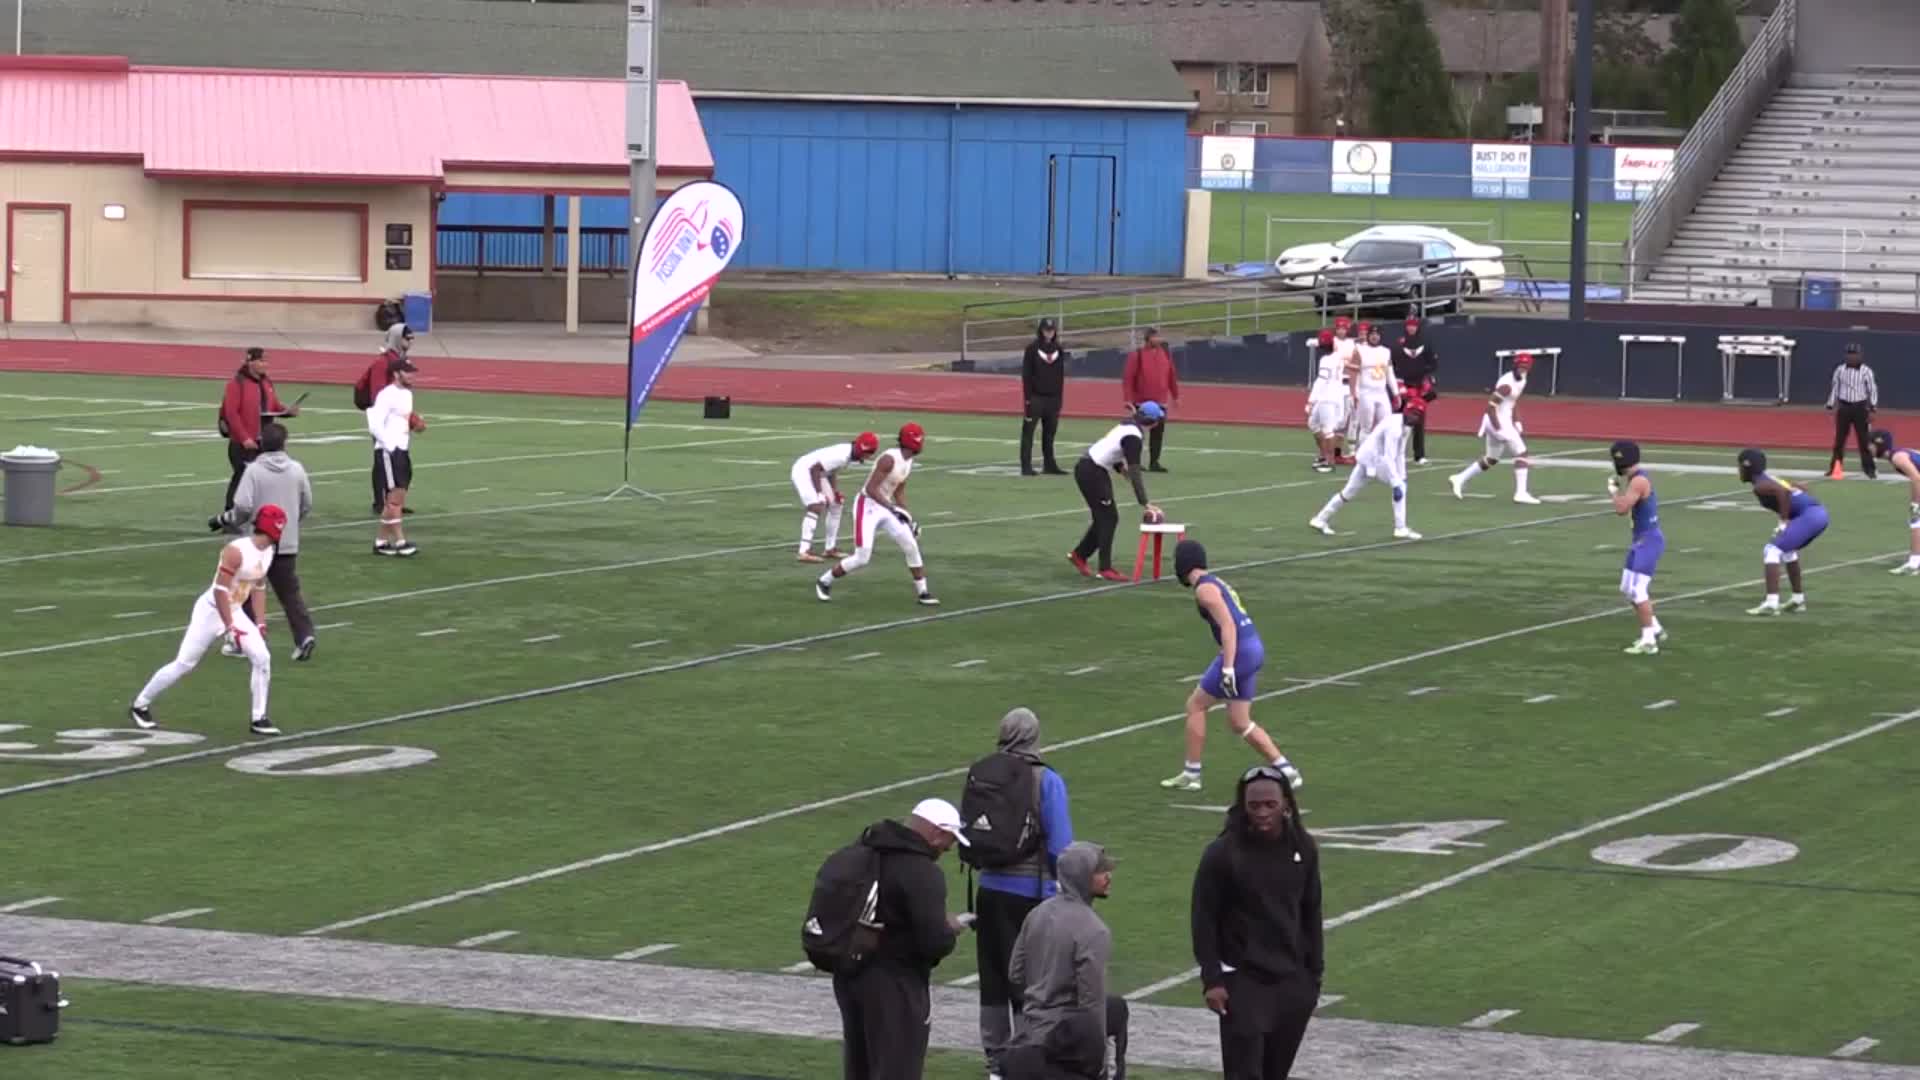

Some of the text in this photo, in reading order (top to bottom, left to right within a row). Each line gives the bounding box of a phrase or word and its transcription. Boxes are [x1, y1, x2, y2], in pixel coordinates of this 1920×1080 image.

[1476, 151, 1528, 162] JUST DO IT
